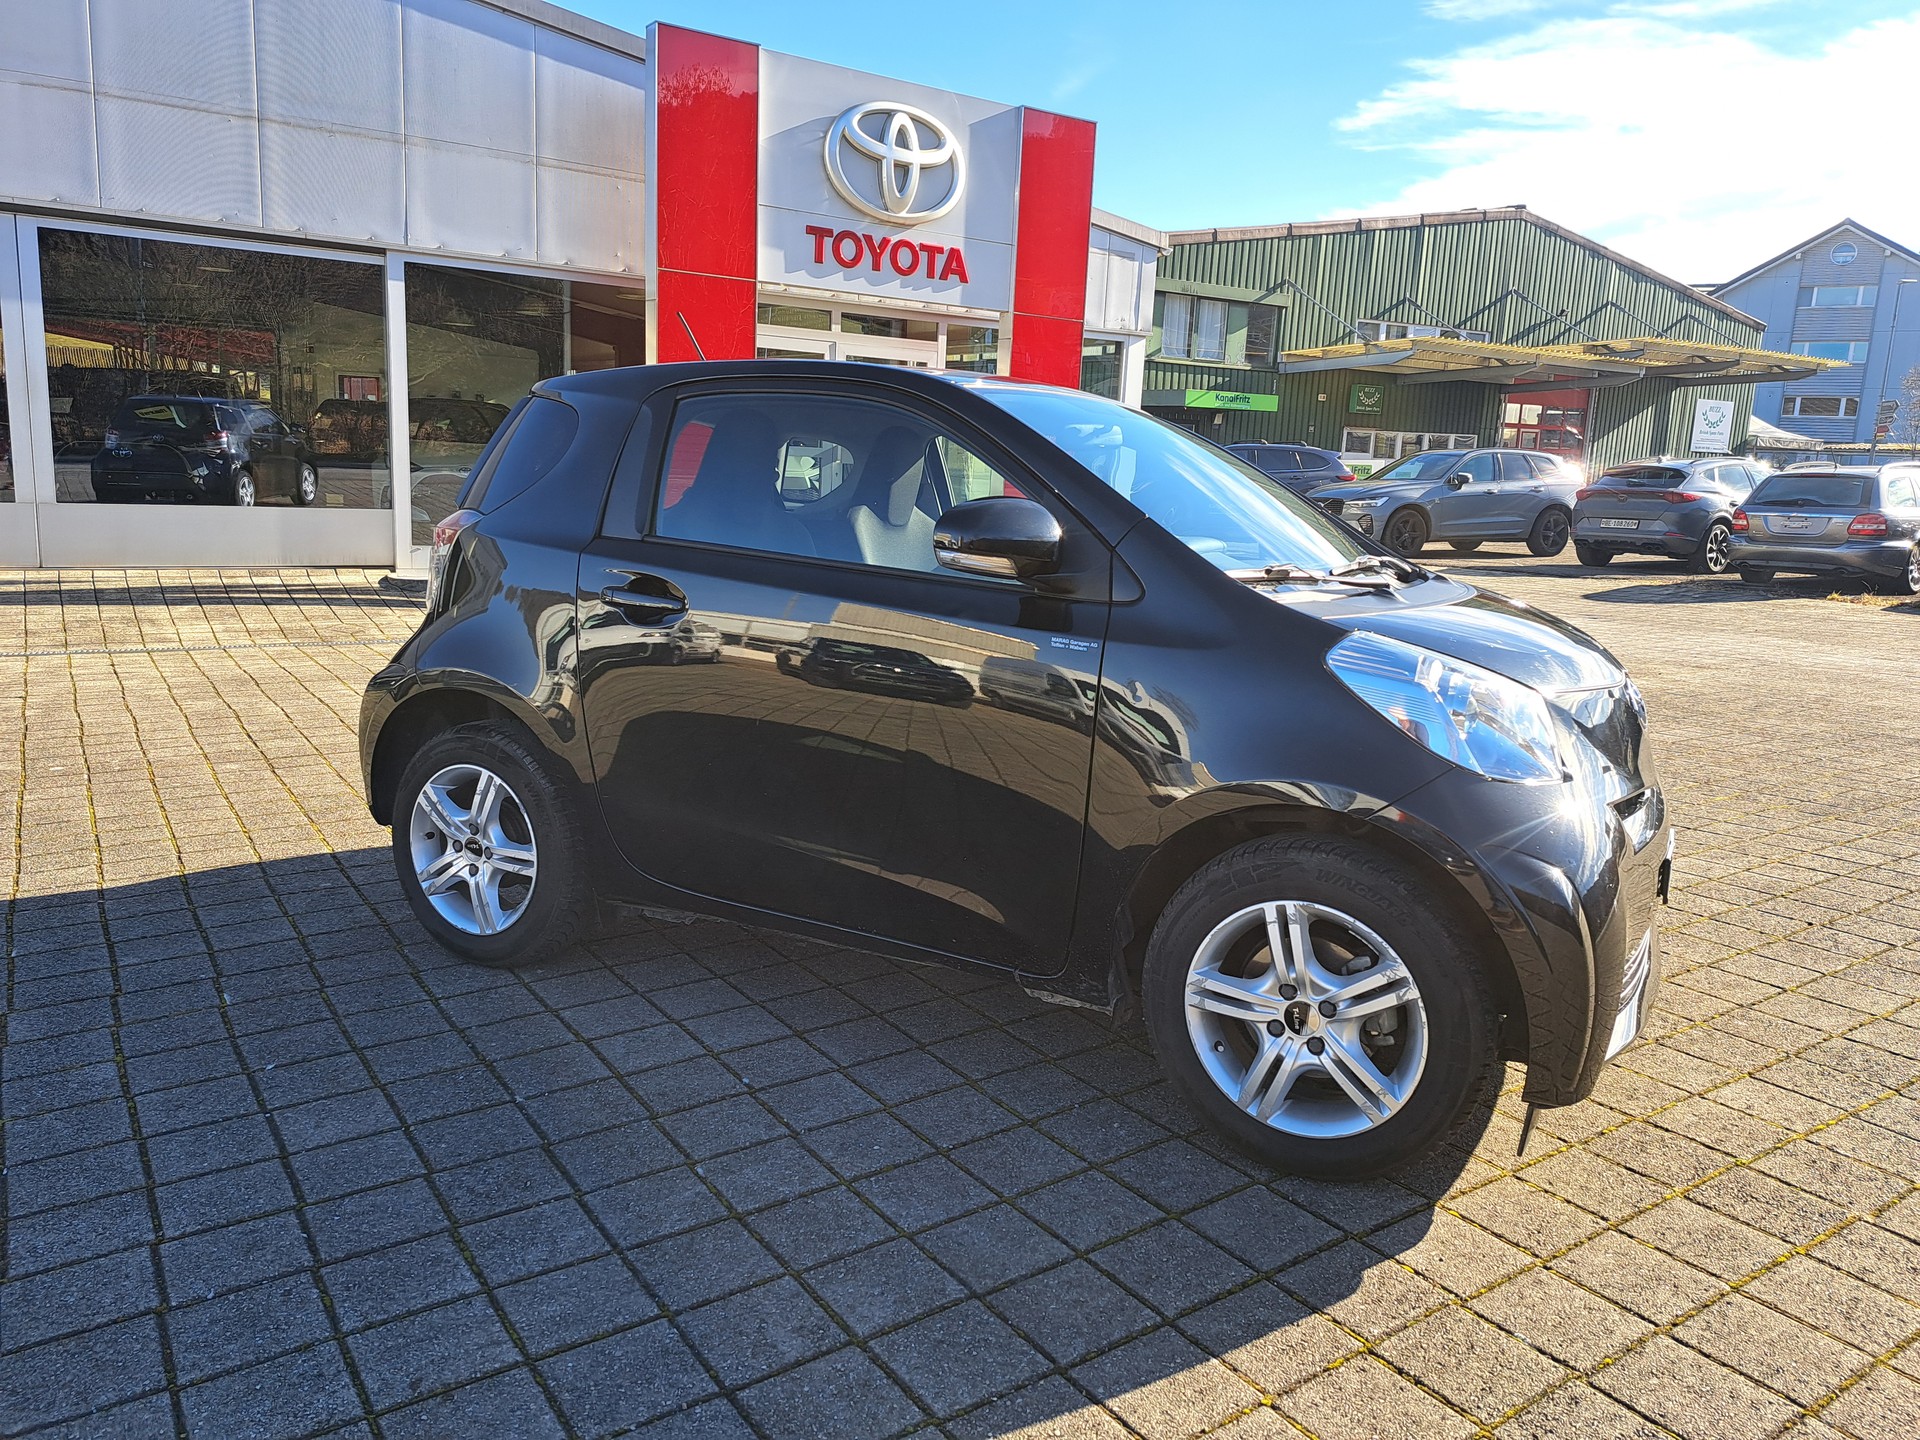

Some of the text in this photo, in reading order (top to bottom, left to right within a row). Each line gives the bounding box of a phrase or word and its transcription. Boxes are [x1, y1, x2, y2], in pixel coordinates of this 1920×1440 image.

[806, 225, 969, 284] TOYOTA
[1215, 392, 1251, 404] KanalFritz
[1051, 636, 1070, 644] MARAG
